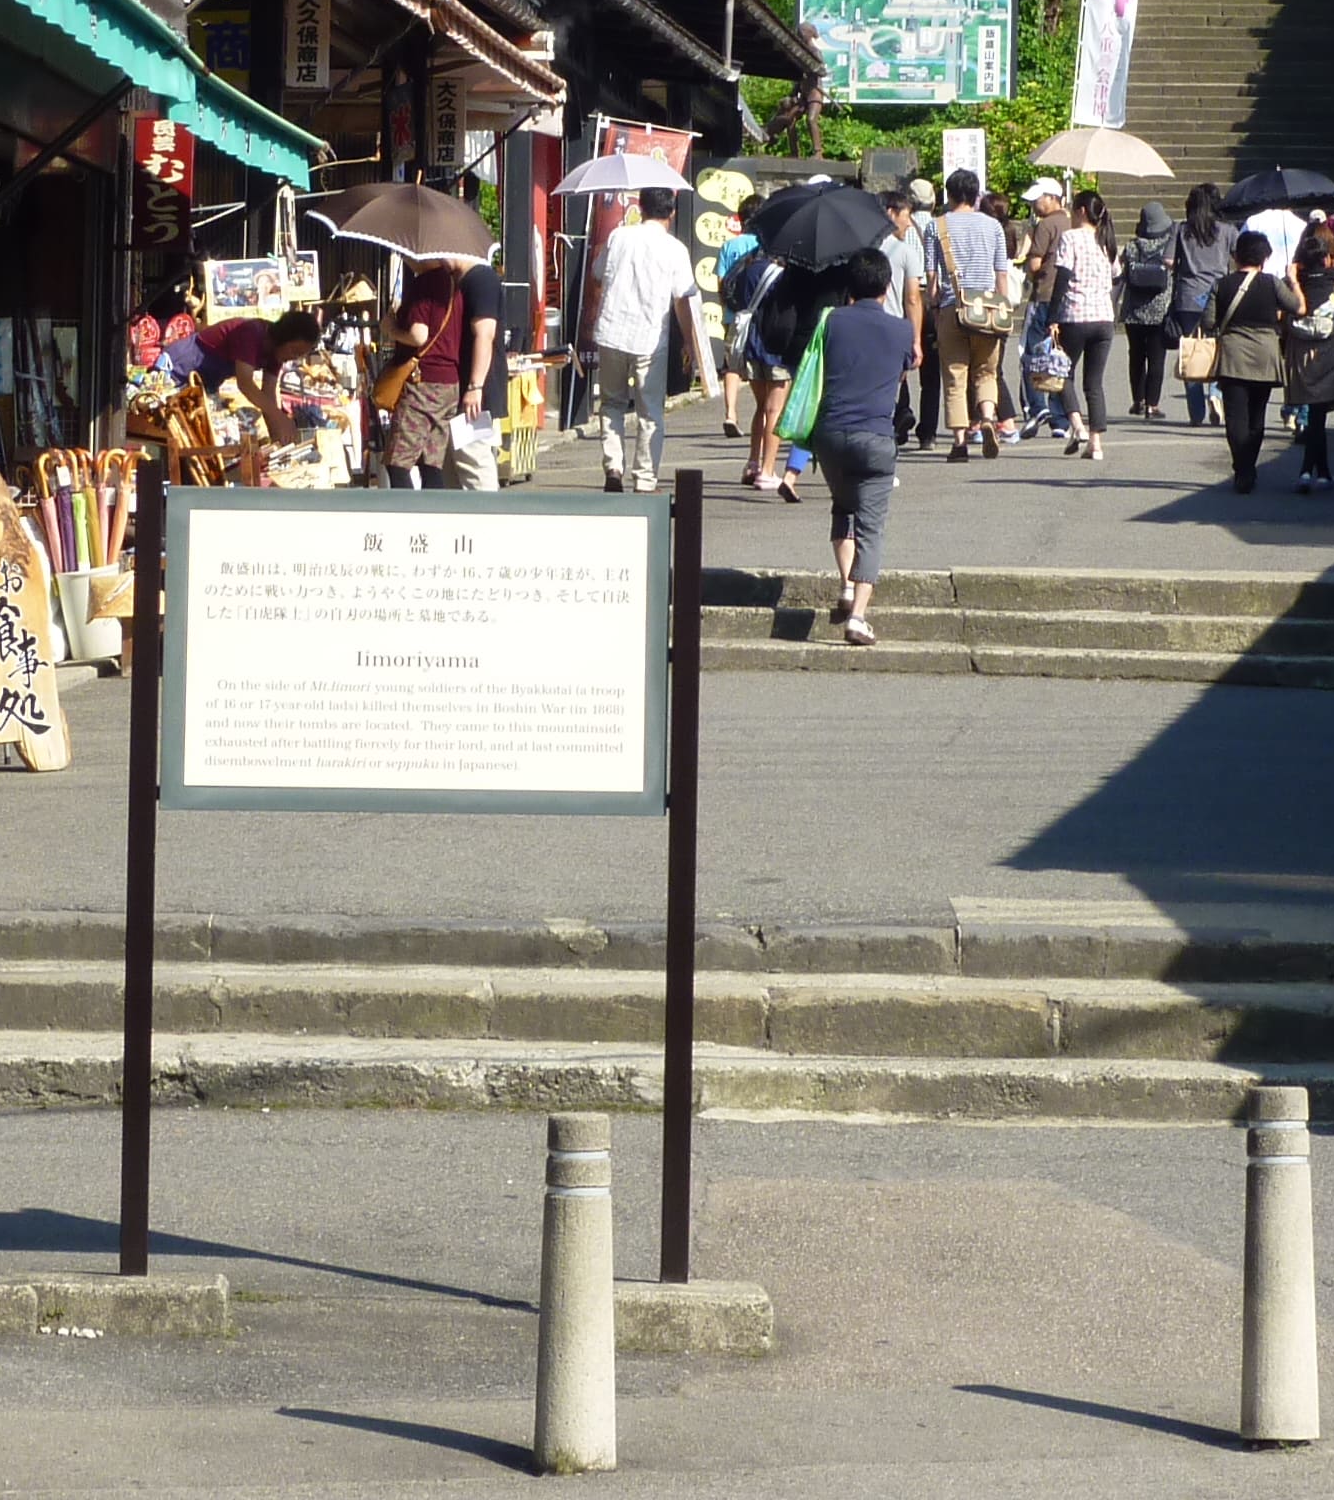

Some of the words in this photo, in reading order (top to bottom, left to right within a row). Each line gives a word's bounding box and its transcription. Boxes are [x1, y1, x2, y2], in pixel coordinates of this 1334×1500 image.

[434, 80, 459, 165] 大久保商店
[140, 153, 184, 244] むとう
[363, 532, 474, 554] 飯盛山
[356, 650, 480, 672] Iimoriyama
